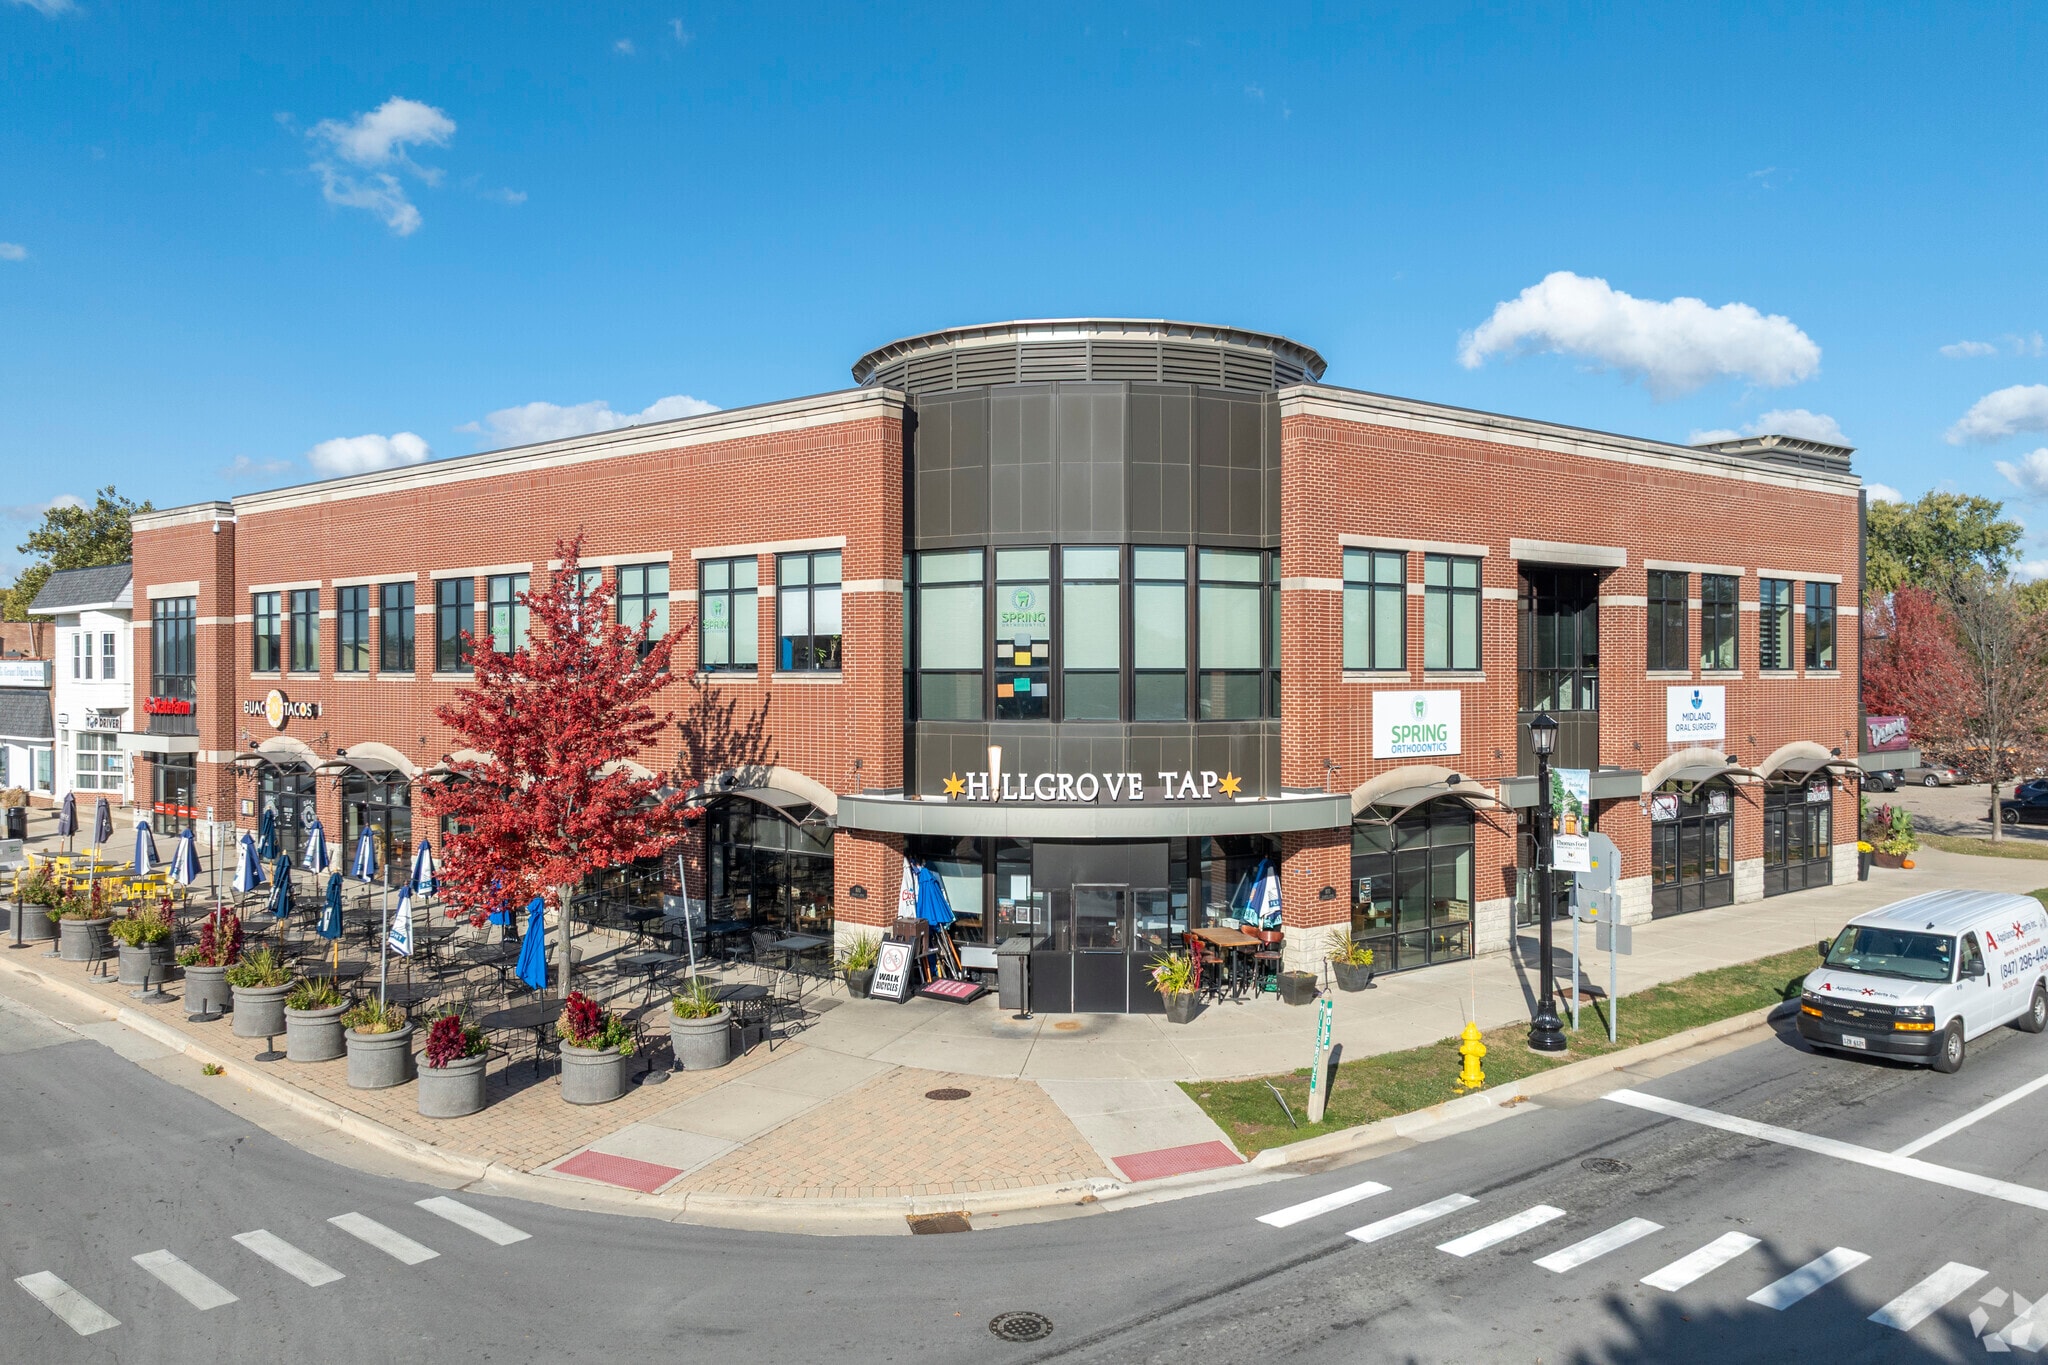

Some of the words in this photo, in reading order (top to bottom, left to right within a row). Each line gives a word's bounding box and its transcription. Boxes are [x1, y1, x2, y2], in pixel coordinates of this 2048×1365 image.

[1001, 611, 1046, 623] SPRING
[243, 701, 266, 715] GUAC
[284, 702, 312, 717] TACOS
[99, 716, 120, 729] DRIVER
[1682, 712, 1711, 721] MIDLAND
[1675, 723, 1691, 731] ORAL
[1692, 722, 1717, 731] SURGERY
[1391, 724, 1447, 743] SPRING
[1391, 743, 1447, 753] ORTHODONTICS
[1158, 770, 1219, 800] TAP
[1986, 931, 1998, 952] A
[2000, 958, 2018, 979] (847)
[2019, 945, 2048, 972] 296-449
[879, 973, 899, 983] WALK
[876, 981, 899, 992] BICYCLES
[1818, 983, 1831, 991] A
